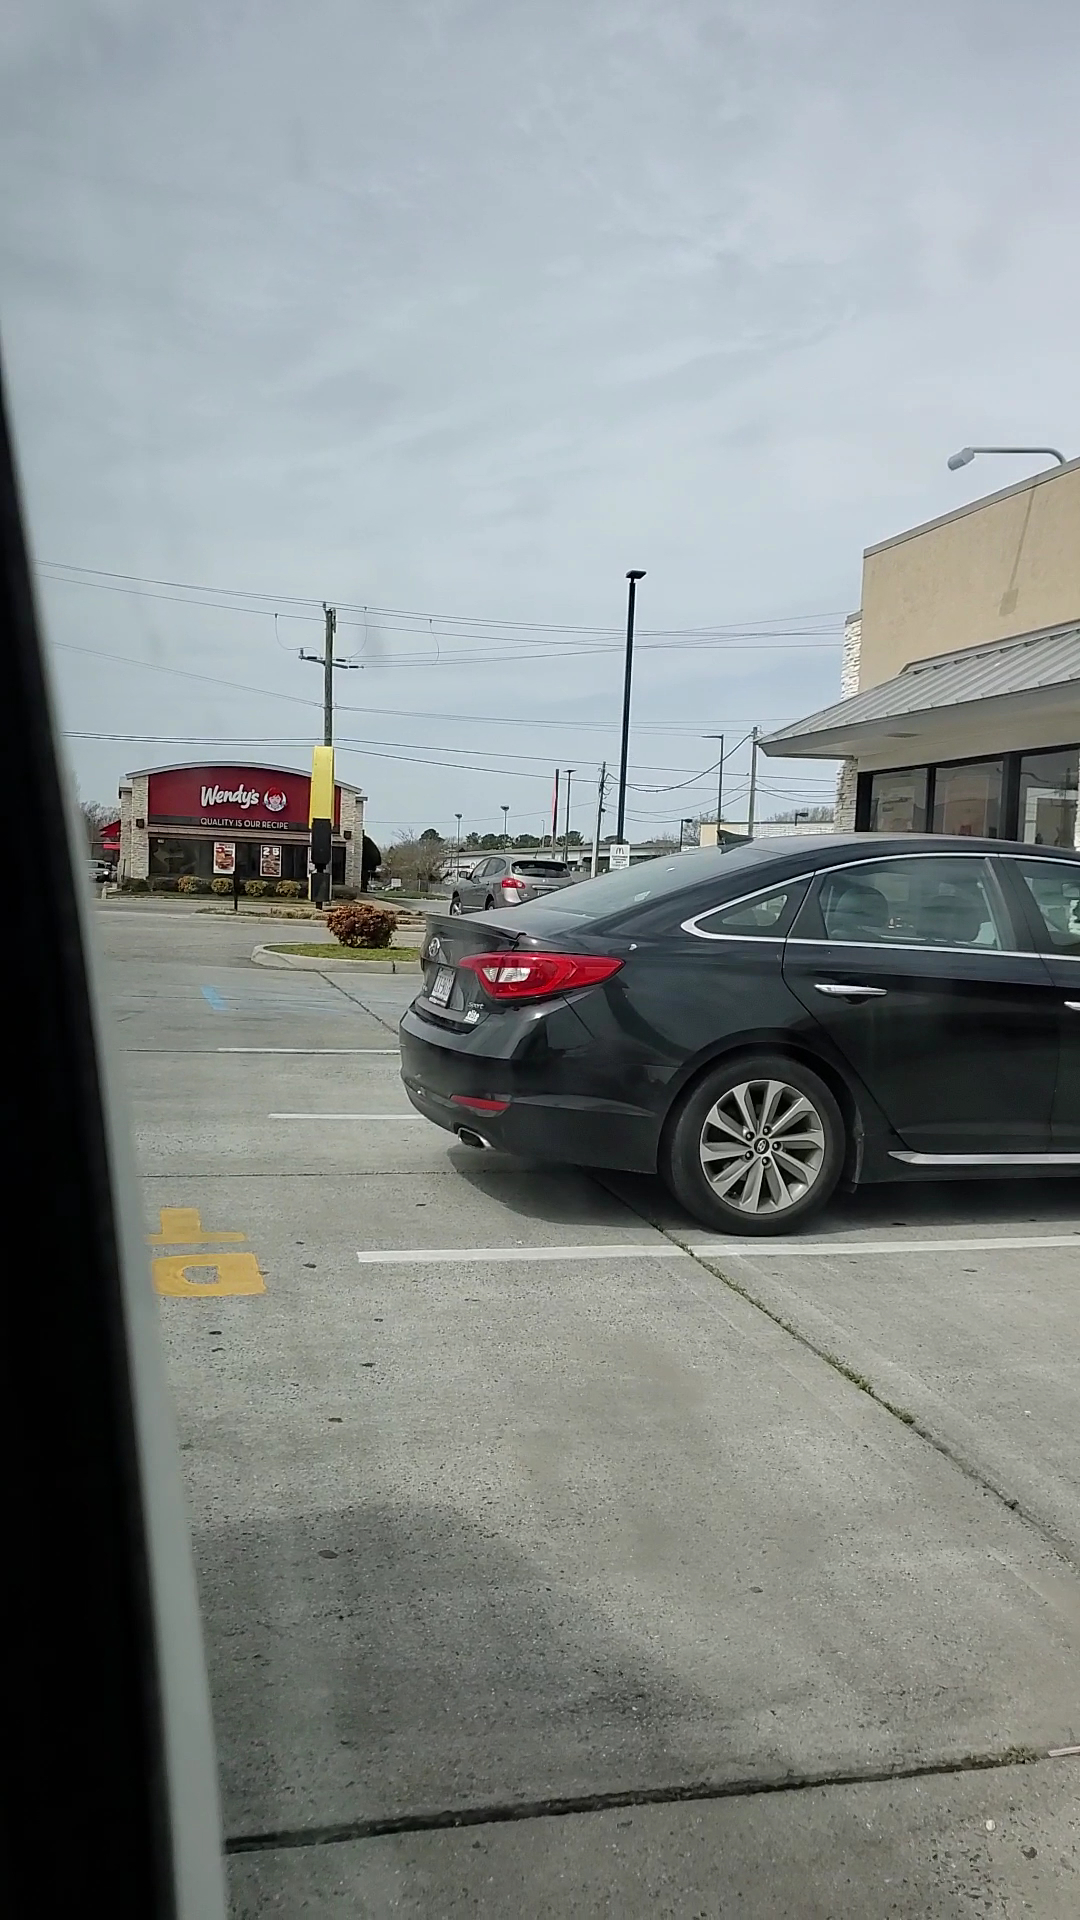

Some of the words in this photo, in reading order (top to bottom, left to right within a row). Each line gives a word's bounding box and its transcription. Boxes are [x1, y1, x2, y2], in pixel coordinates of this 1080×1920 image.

[201, 784, 259, 809] Wendy's
[200, 817, 234, 827] QUALITY
[235, 819, 243, 827] IS
[244, 820, 261, 828] OUR
[262, 821, 289, 829] RECIPE
